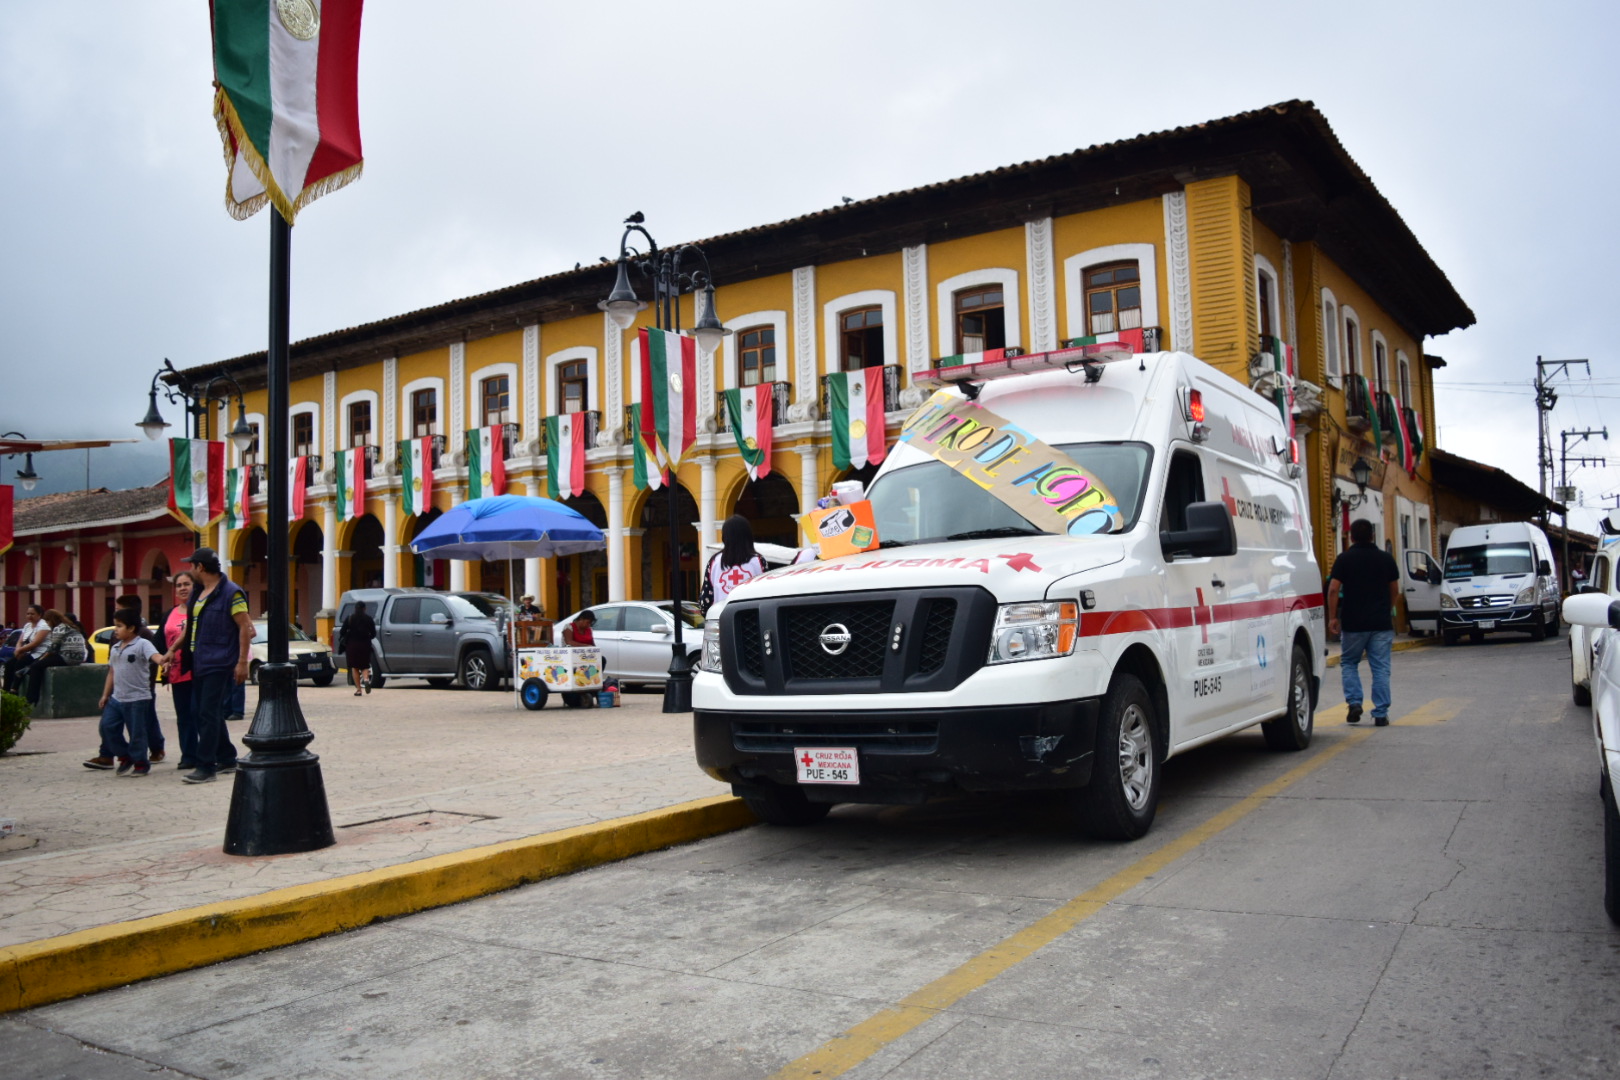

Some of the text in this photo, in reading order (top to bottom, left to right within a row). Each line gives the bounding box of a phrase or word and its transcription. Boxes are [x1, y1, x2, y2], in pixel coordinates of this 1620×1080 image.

[1193, 676, 1222, 698] PUE-545
[815, 752, 853, 760] CRUZ ROJA
[817, 761, 852, 769] MEXICANA
[806, 768, 825, 779] PUE
[832, 769, 848, 780] 545
